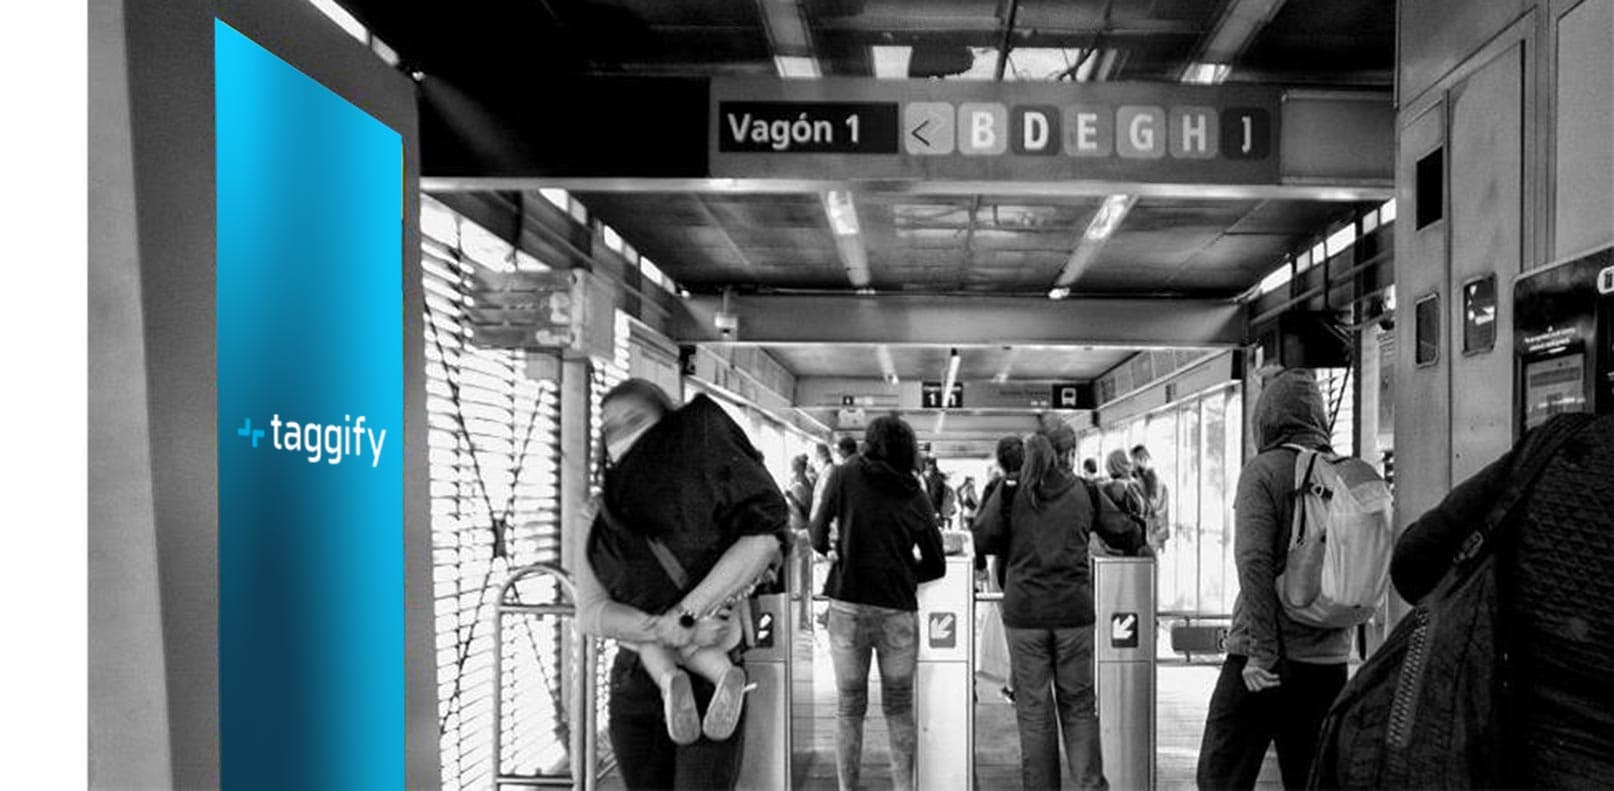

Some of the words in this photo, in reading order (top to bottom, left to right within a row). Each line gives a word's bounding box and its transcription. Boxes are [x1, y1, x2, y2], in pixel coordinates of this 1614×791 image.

[727, 112, 833, 150] Vagón
[845, 113, 859, 143] 1
[971, 111, 996, 150] B
[1023, 111, 1049, 151] D
[1077, 112, 1098, 151] E
[1129, 113, 1154, 151] G
[1182, 114, 1206, 151] H
[270, 413, 387, 468] taggify
